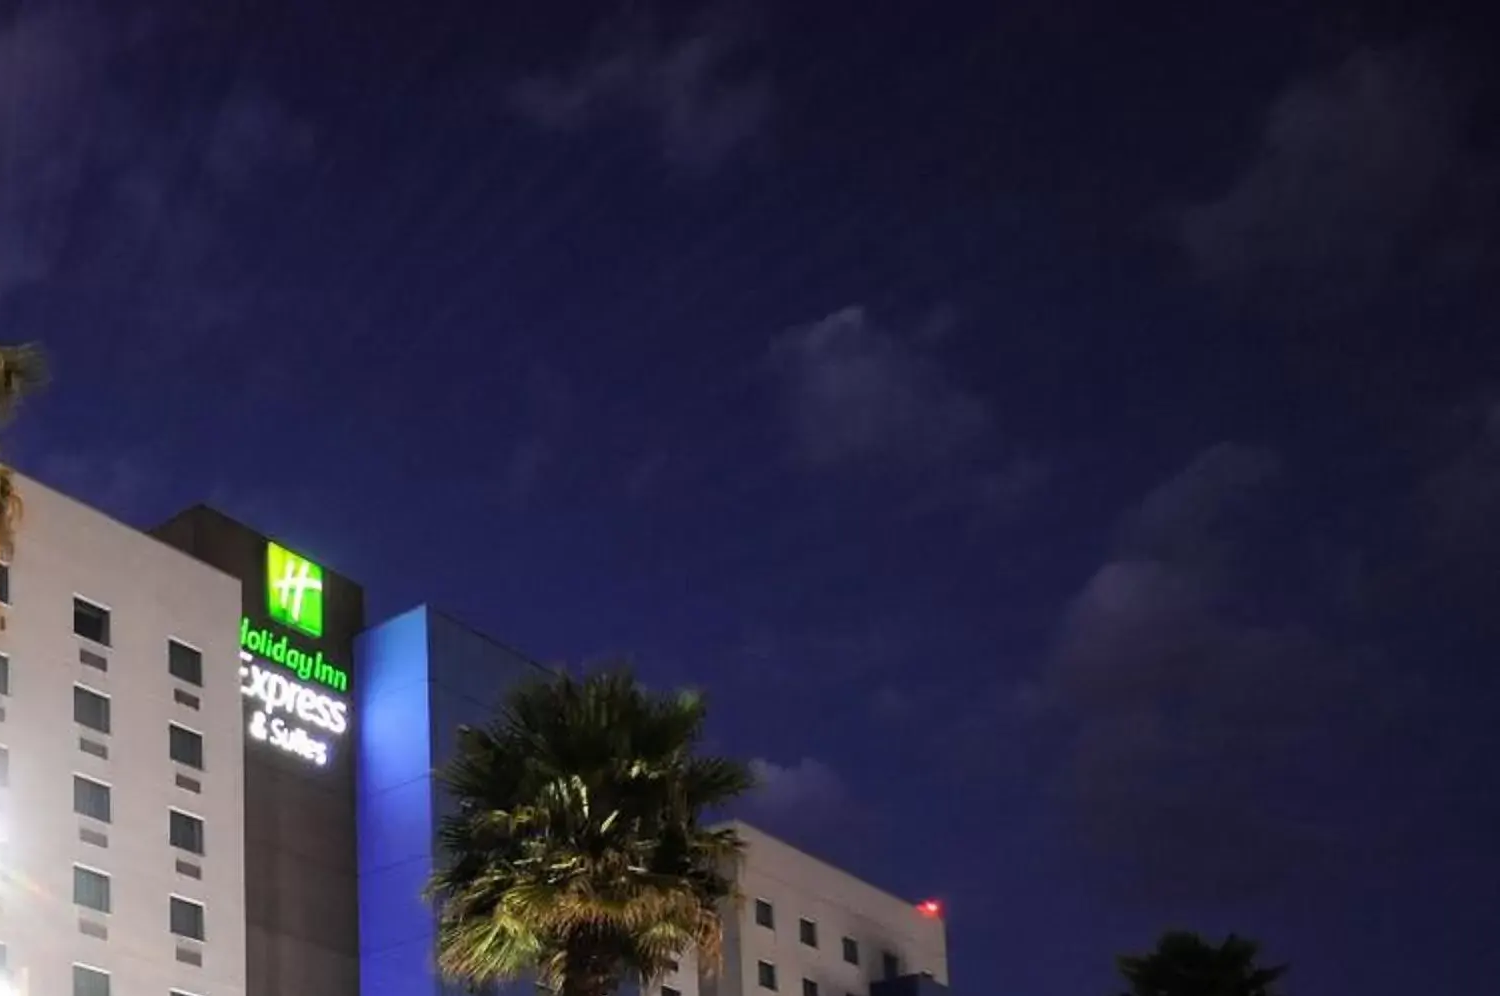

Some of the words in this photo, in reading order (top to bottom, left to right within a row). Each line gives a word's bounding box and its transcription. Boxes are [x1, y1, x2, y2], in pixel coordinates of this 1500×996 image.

[313, 651, 347, 692] Inn
[249, 710, 268, 741] &
[269, 717, 328, 767] Suites
